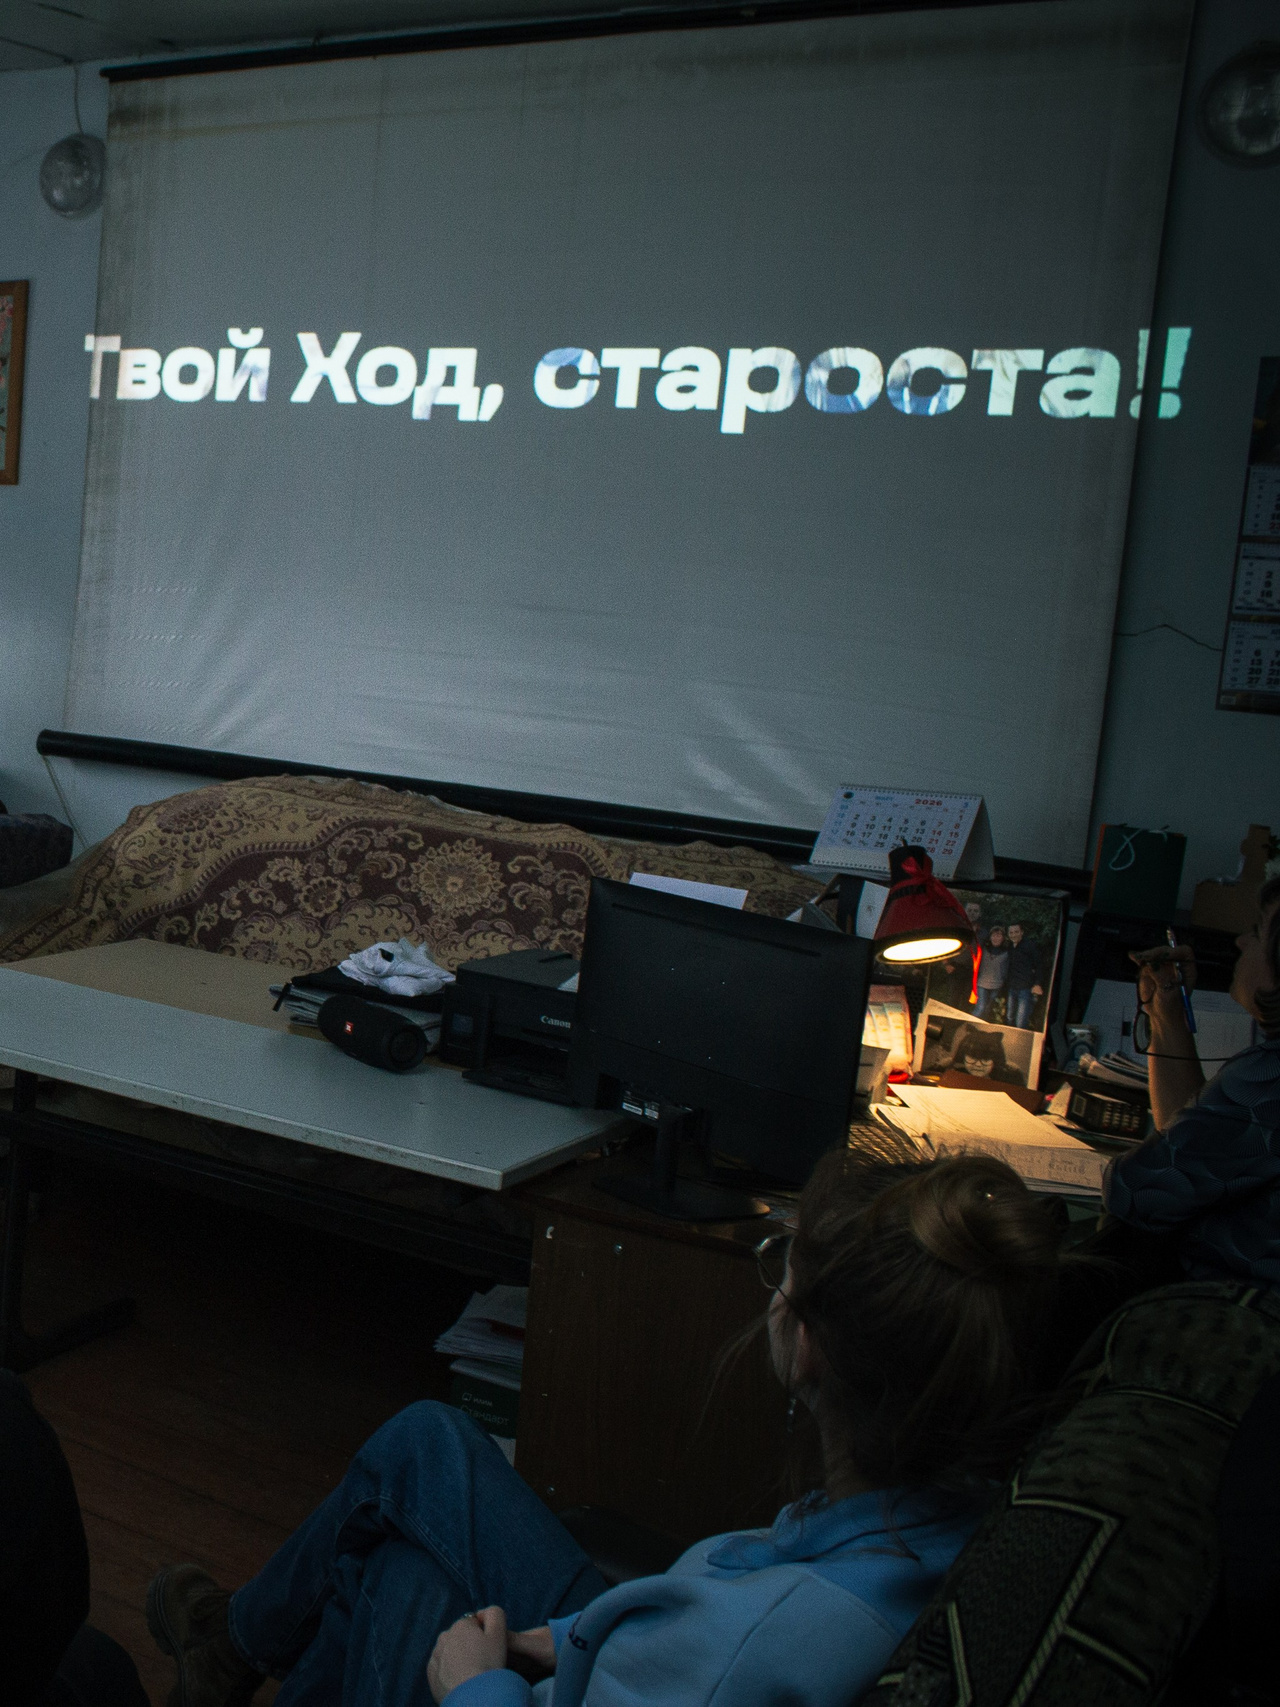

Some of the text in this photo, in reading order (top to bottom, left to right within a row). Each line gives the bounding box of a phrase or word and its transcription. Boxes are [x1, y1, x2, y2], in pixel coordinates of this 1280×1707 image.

[84, 327, 271, 402] Твой
[290, 331, 504, 422] Ход,
[915, 798, 943, 806] 2026
[540, 1013, 572, 1029] Canon
